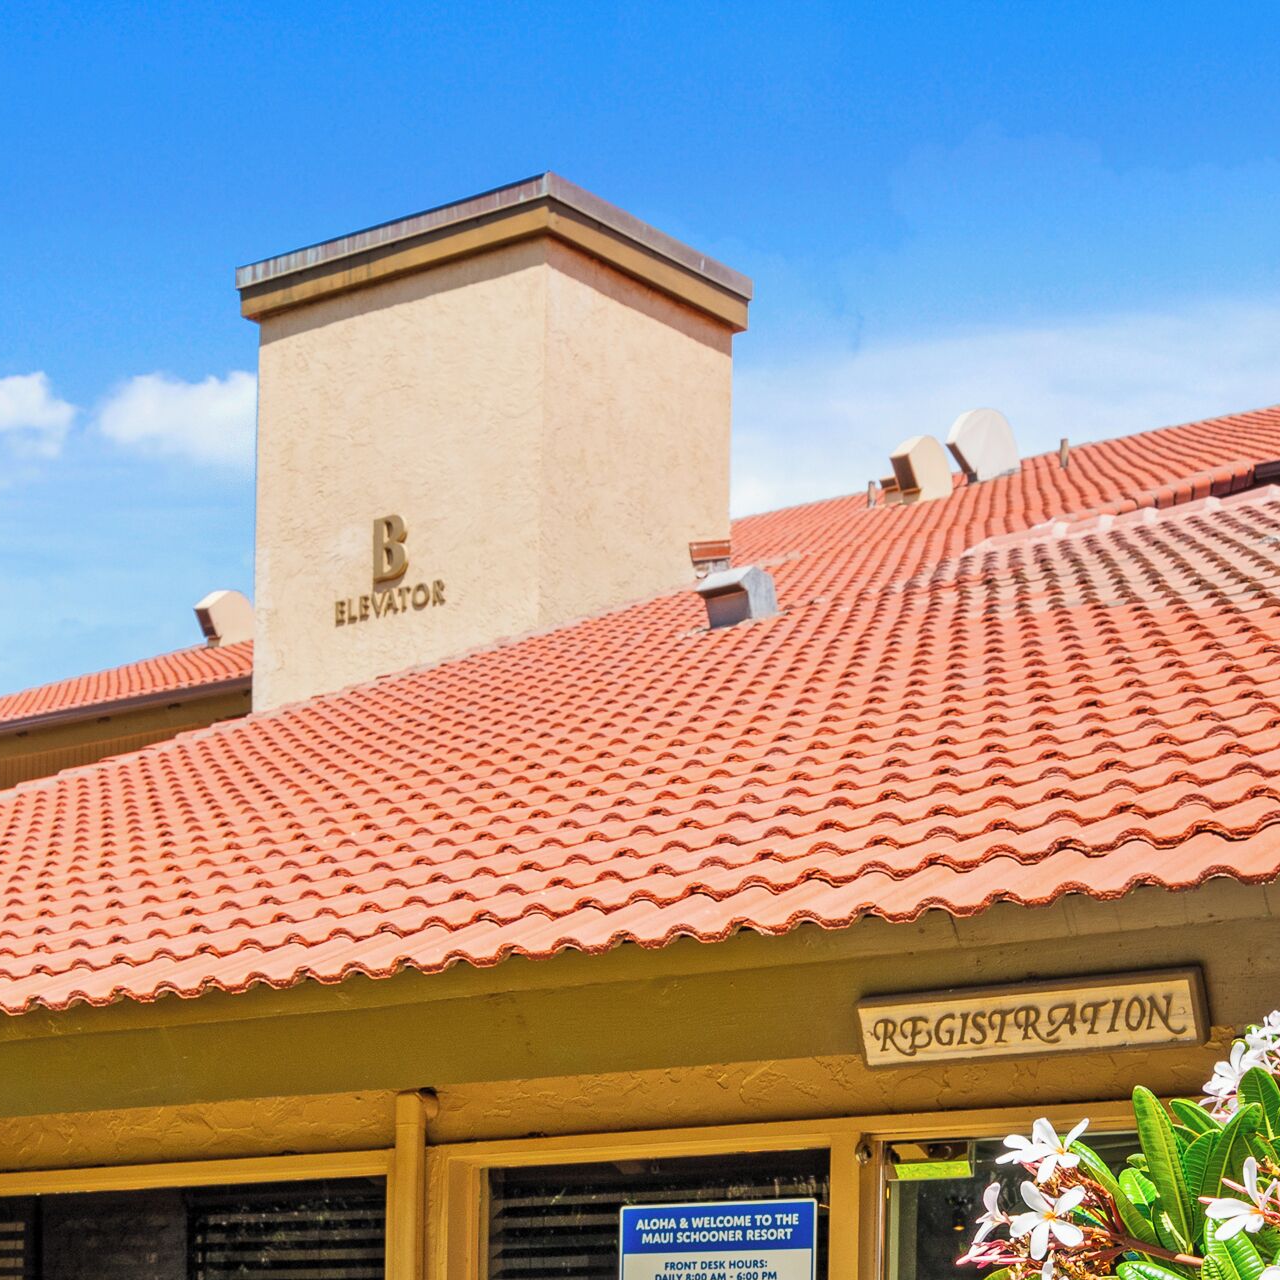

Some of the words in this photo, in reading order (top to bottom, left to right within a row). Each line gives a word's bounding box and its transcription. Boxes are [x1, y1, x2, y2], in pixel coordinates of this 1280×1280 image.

[373, 514, 409, 583] B
[335, 579, 446, 628] ELEVATOR
[873, 993, 1187, 1057] REGISTRATION
[636, 1219, 677, 1230] ALOHA
[680, 1218, 688, 1228] &
[691, 1216, 751, 1228] WELCOME
[754, 1215, 772, 1226] TO
[775, 1213, 799, 1225] THE
[641, 1232, 673, 1244] MAUI
[676, 1230, 743, 1243] SCHOONER
[746, 1228, 793, 1241] RESORT
[664, 1261, 698, 1271] FRONT
[700, 1260, 725, 1270] DESK
[728, 1259, 768, 1269] HOURS:
[736, 1272, 759, 1280] 6:00
[761, 1271, 777, 1280] PM
